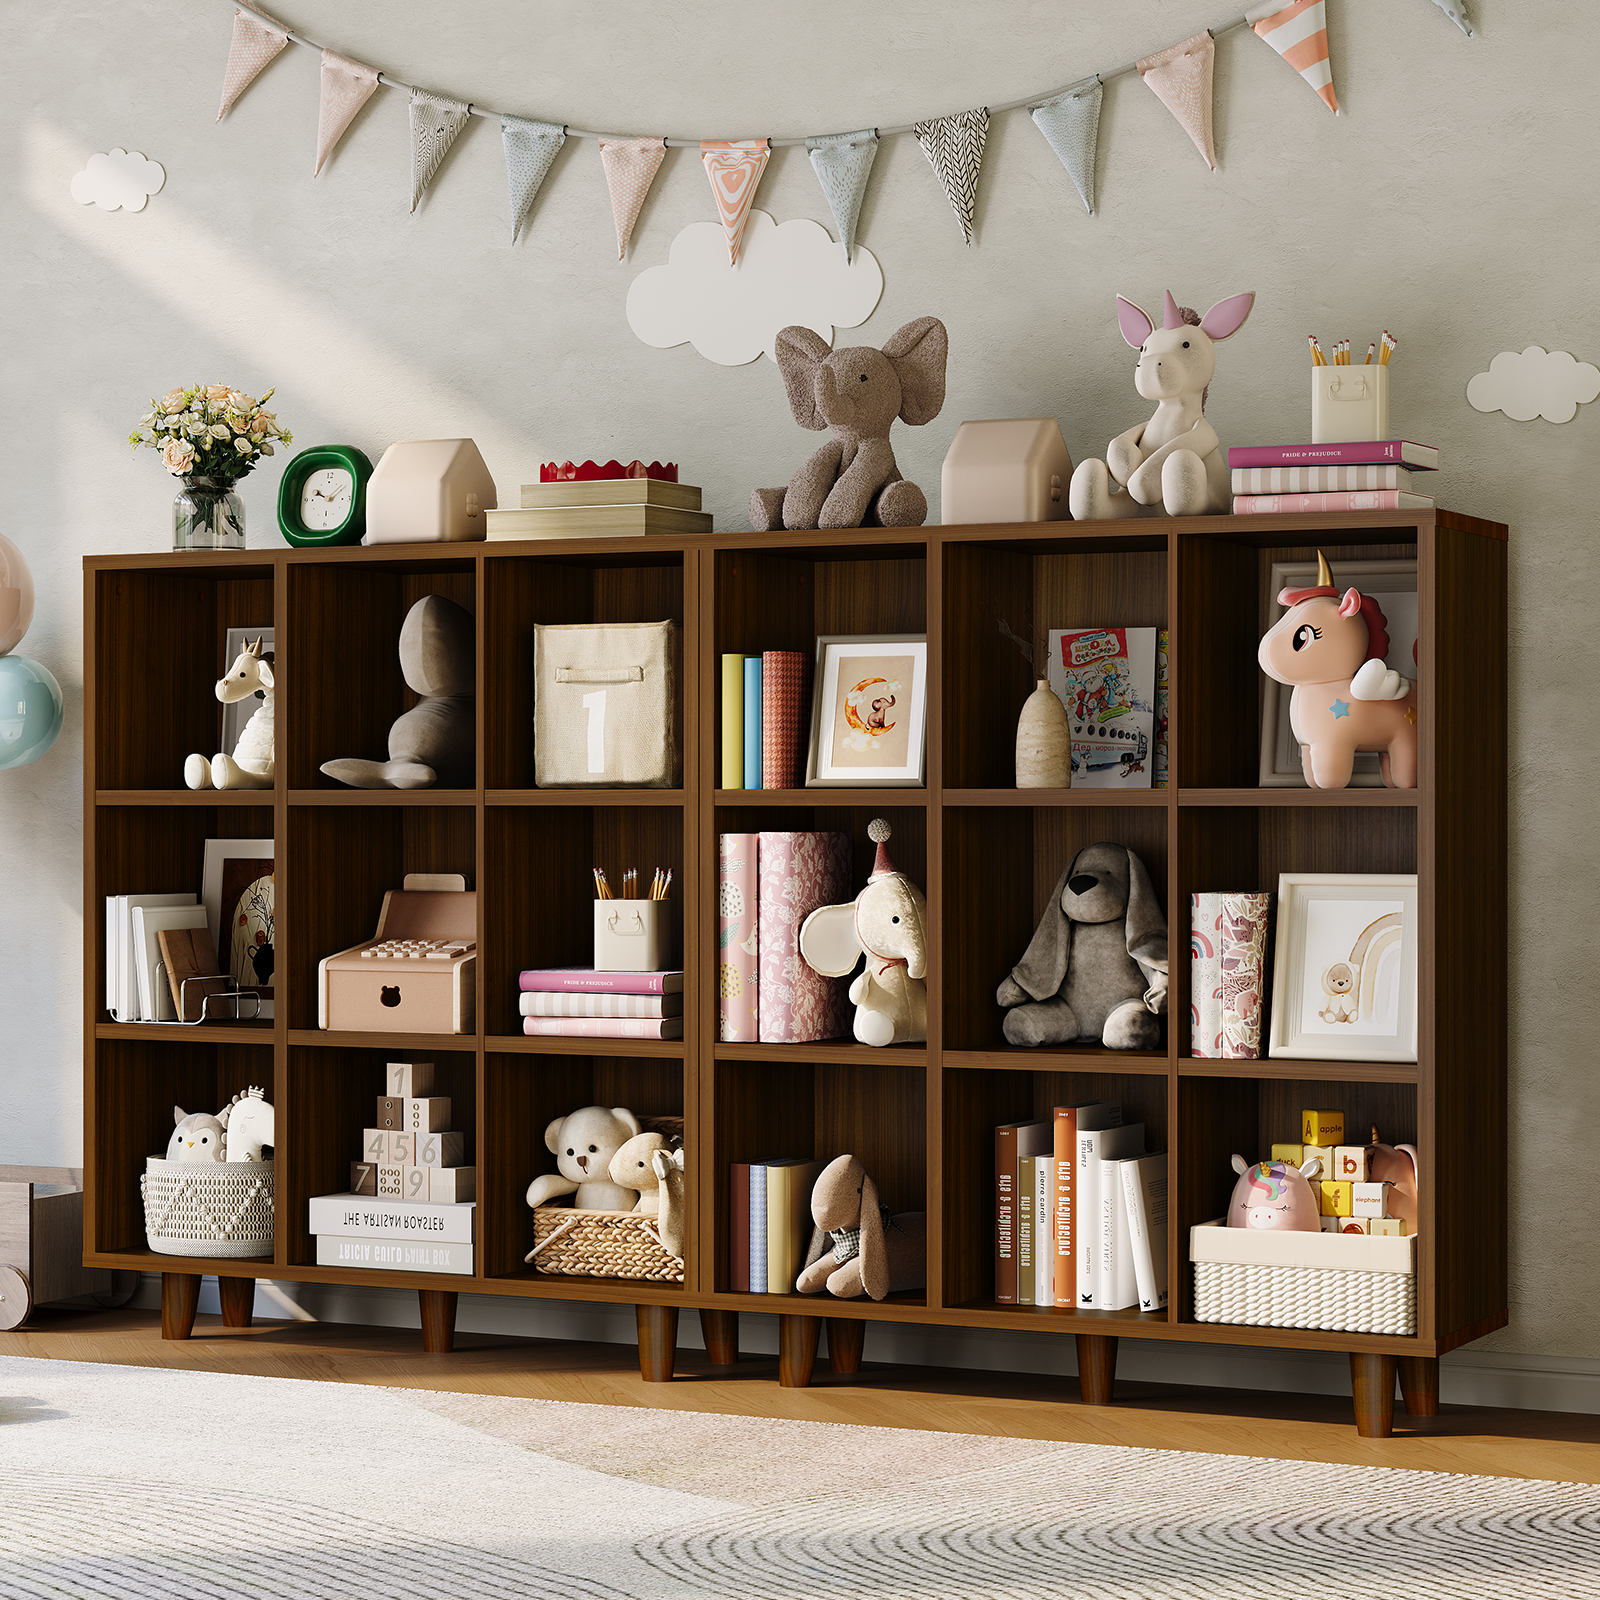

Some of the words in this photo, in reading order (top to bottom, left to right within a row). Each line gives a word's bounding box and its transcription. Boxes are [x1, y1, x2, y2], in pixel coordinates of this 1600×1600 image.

[583, 690, 606, 773] 1
[1072, 743, 1091, 752] Дед
[394, 1067, 404, 1094] 1
[1305, 1120, 1312, 1137] A
[1320, 1125, 1342, 1134] apple
[368, 1133, 384, 1160] 4
[394, 1135, 409, 1161] 5
[422, 1137, 436, 1164] 6
[1344, 1155, 1357, 1174] b
[354, 1165, 370, 1192] 7
[410, 1170, 423, 1196] 9
[1332, 1189, 1340, 1208] f
